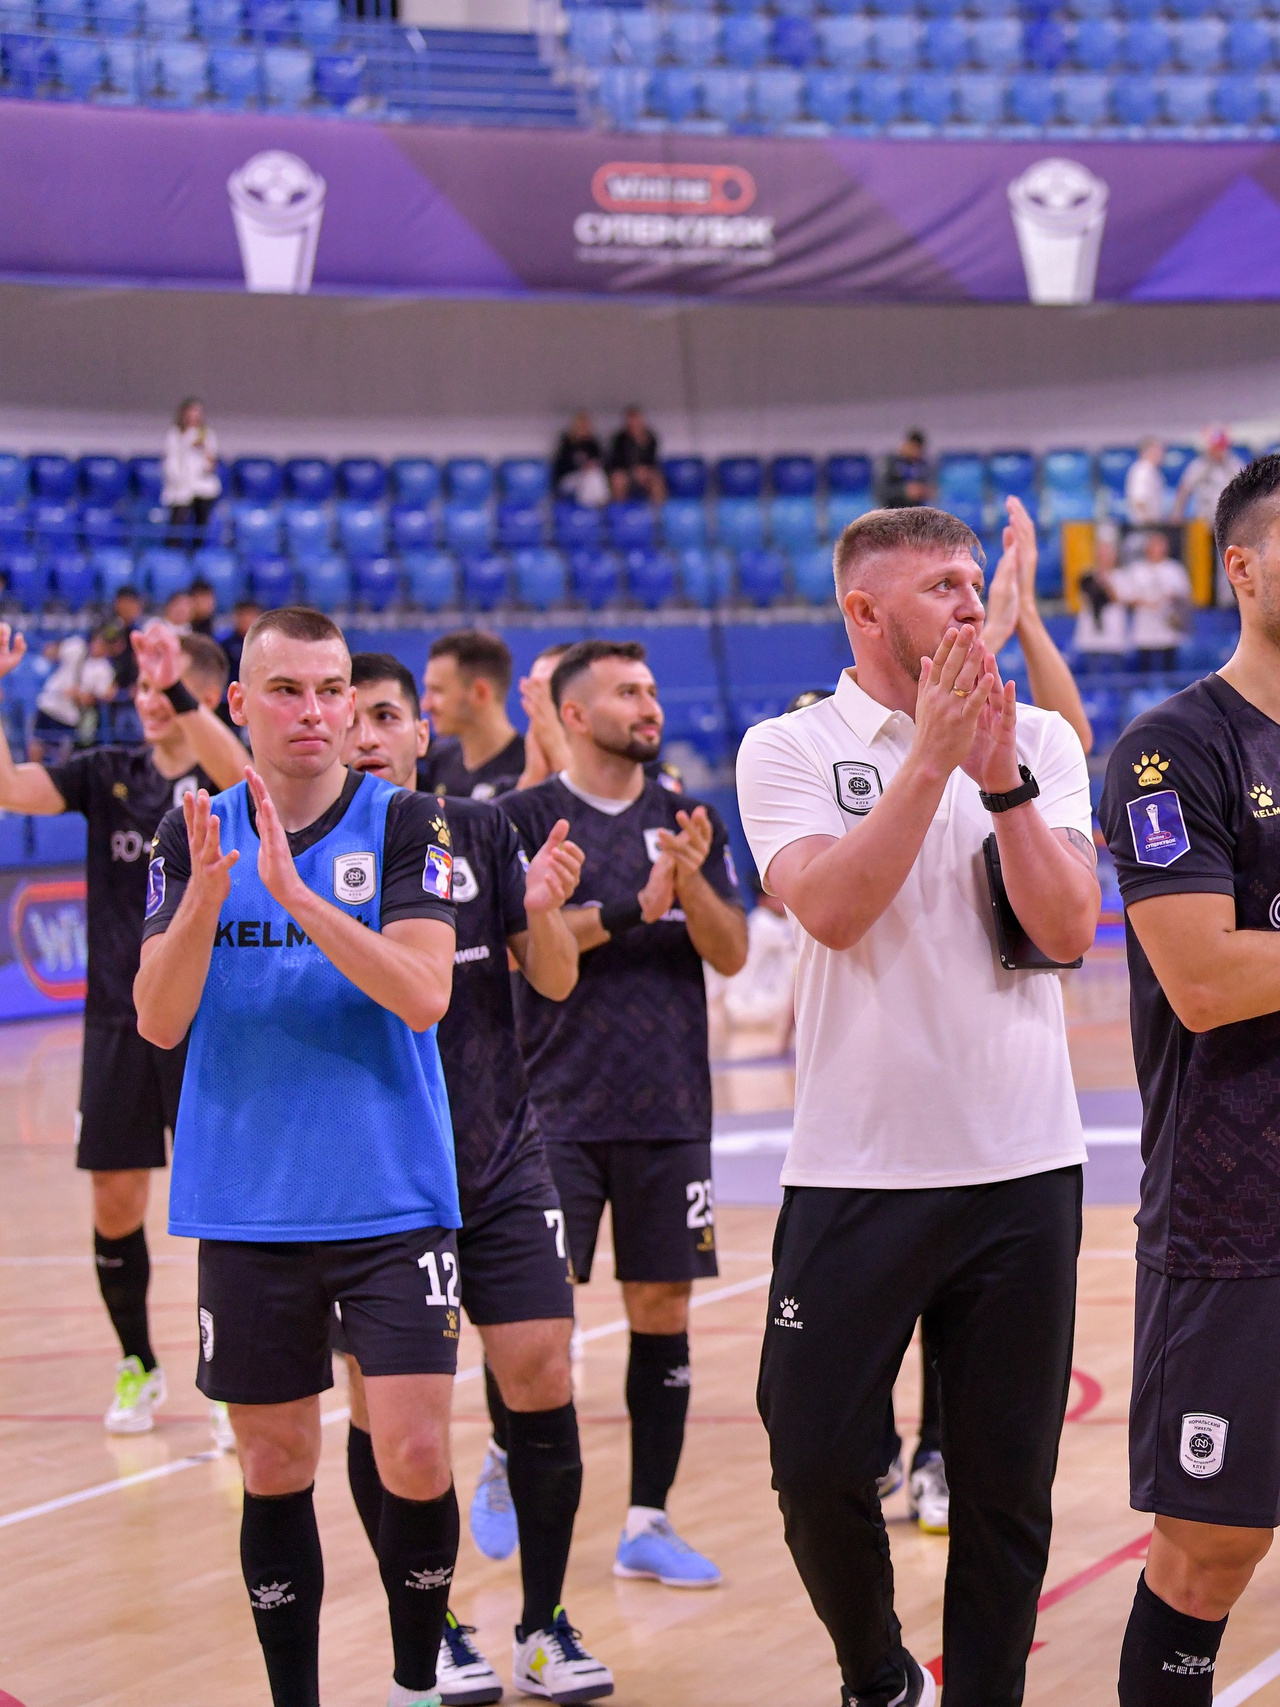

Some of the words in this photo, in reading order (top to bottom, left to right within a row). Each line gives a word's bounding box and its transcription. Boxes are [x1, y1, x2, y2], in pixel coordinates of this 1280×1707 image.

[213, 920, 314, 948] KELM
[543, 1208, 567, 1259] 7
[417, 1251, 460, 1308] 12
[774, 1317, 804, 1330] KELME
[251, 1593, 296, 1610] KELME
